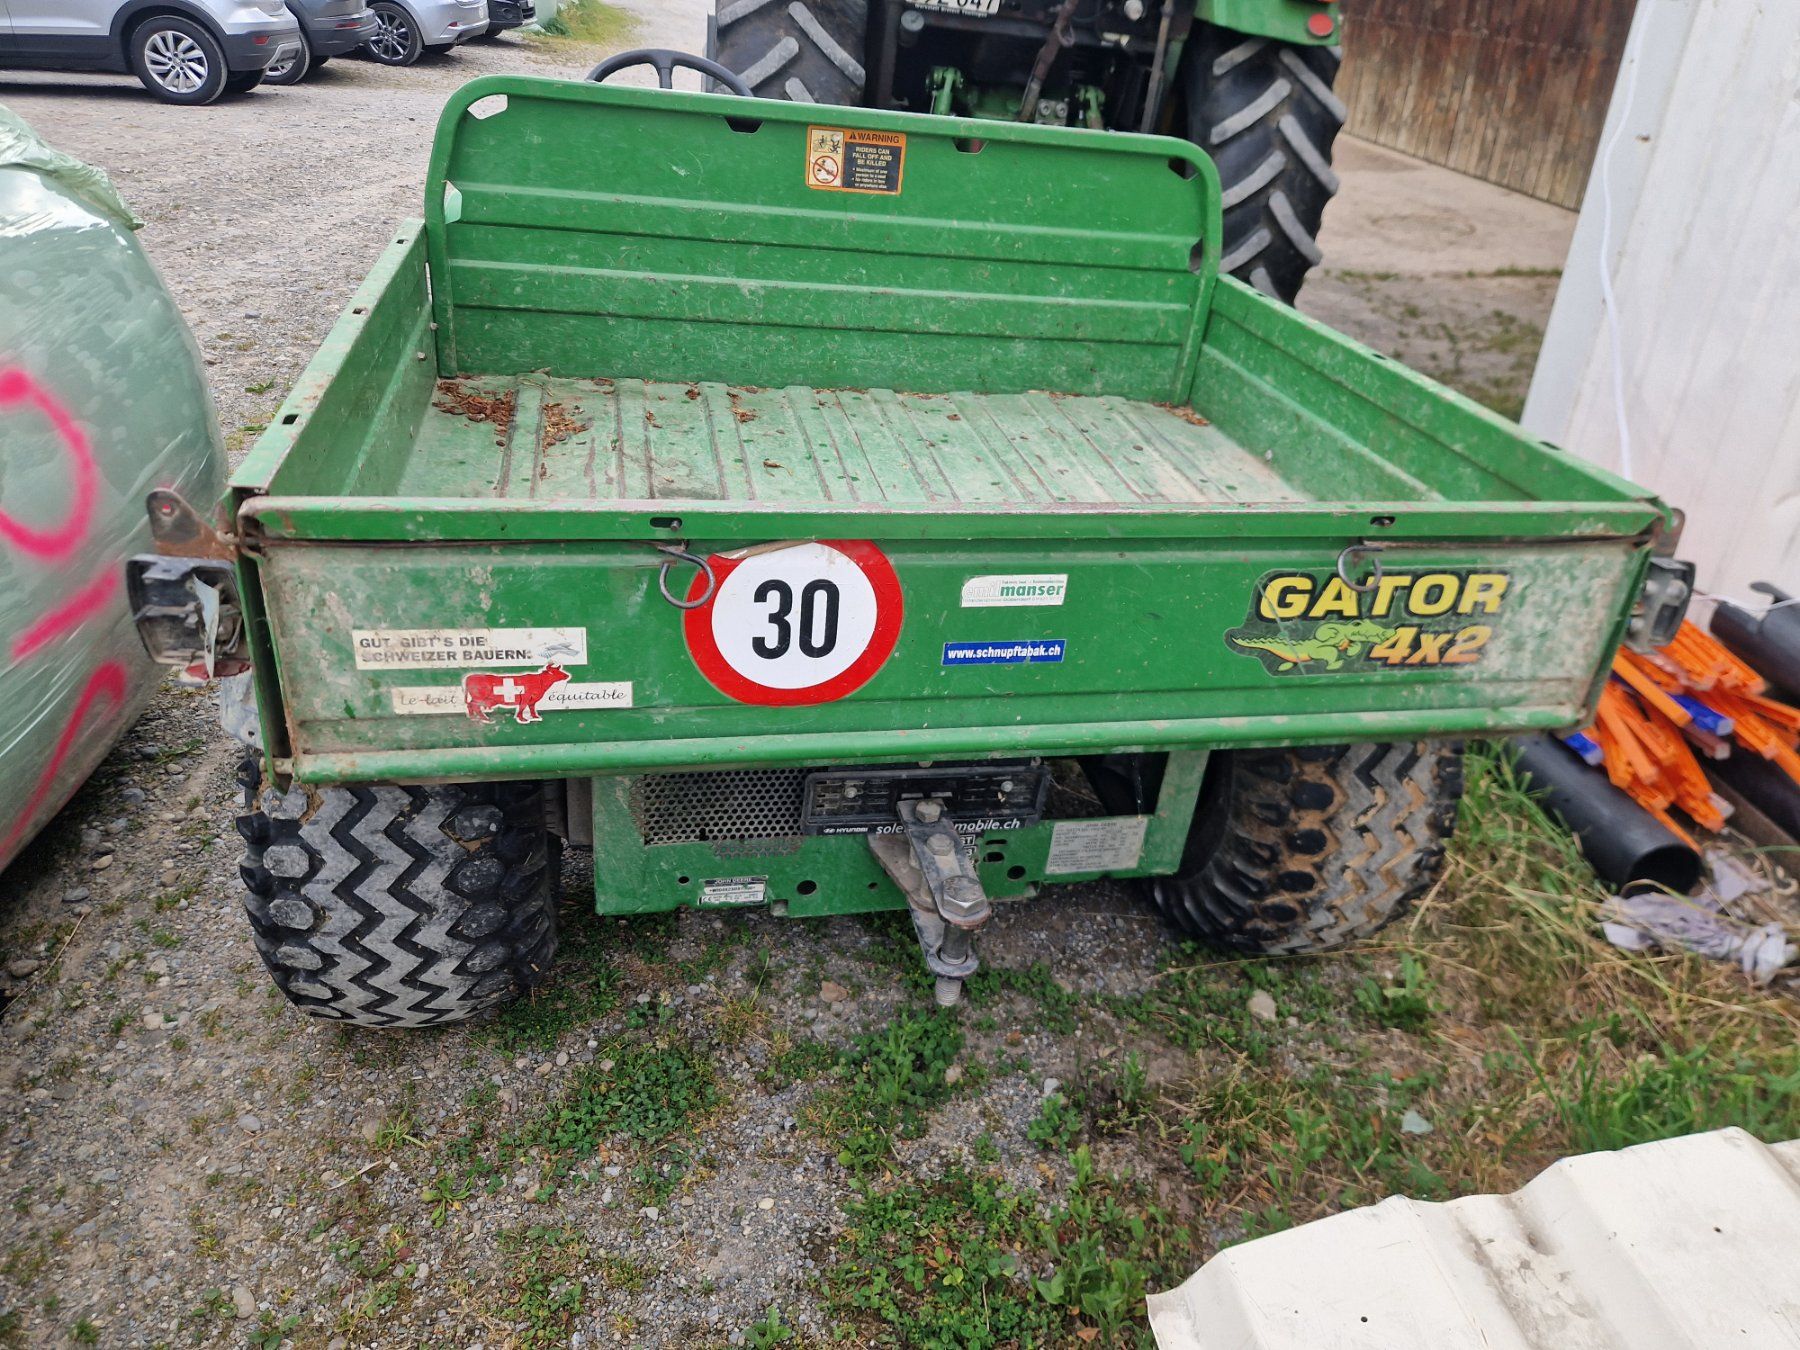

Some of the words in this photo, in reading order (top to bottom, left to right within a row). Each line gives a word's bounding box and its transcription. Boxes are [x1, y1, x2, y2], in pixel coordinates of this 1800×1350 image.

[857, 132, 899, 144] WARNING
[855, 146, 877, 154] RIDERS
[1000, 585, 1064, 596] manser
[1260, 573, 1508, 619] GATOR
[752, 579, 840, 659] 30
[947, 644, 1061, 659] www.schnupftabak.ch
[1368, 625, 1492, 665] 4x2
[548, 689, 627, 705] équitable
